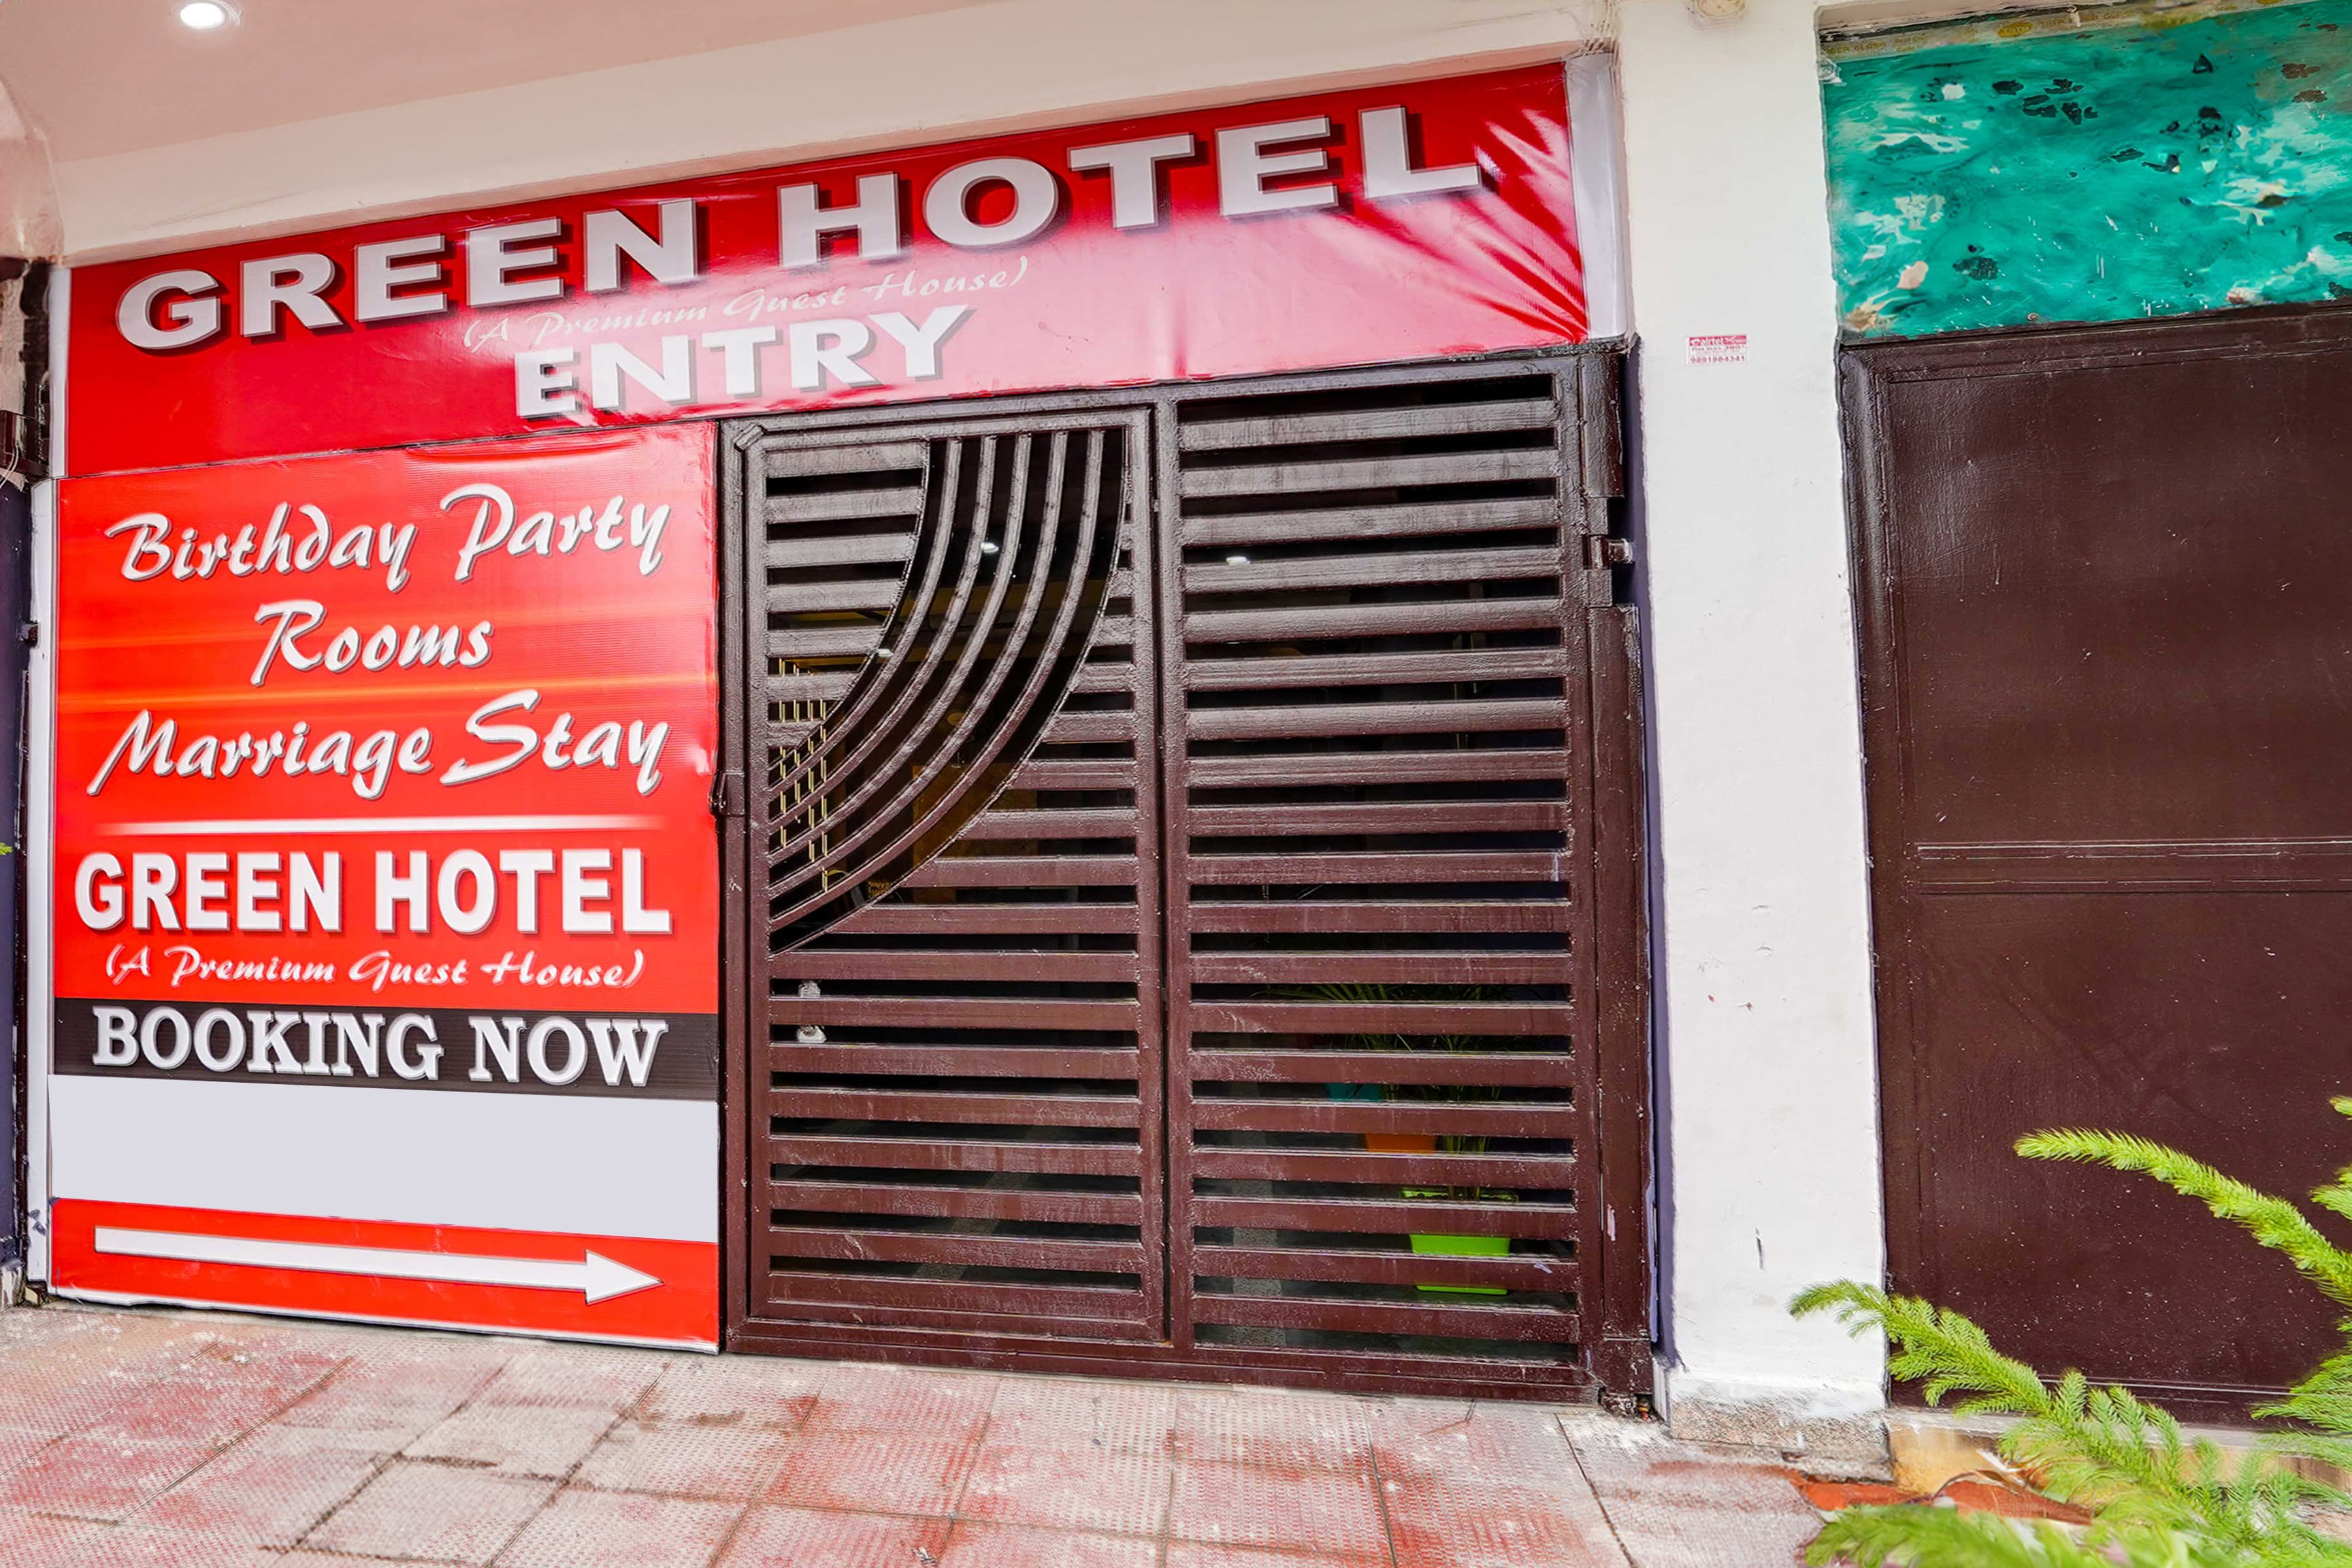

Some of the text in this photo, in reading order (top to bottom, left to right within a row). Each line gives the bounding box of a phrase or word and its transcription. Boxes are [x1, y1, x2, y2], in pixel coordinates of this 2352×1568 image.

[115, 105, 1482, 350] GREEN HOTEL
[463, 255, 1029, 353] (A Premium Guest House)
[514, 305, 970, 417] ENTRY
[104, 483, 671, 591] Birthday Party
[250, 600, 493, 686] Rooms
[86, 689, 671, 799] Marriage Stay
[74, 847, 673, 935] GREEN HOTEL
[105, 943, 644, 991] (A Premium Guest House)
[92, 1005, 668, 1086] BOOKING NOW
